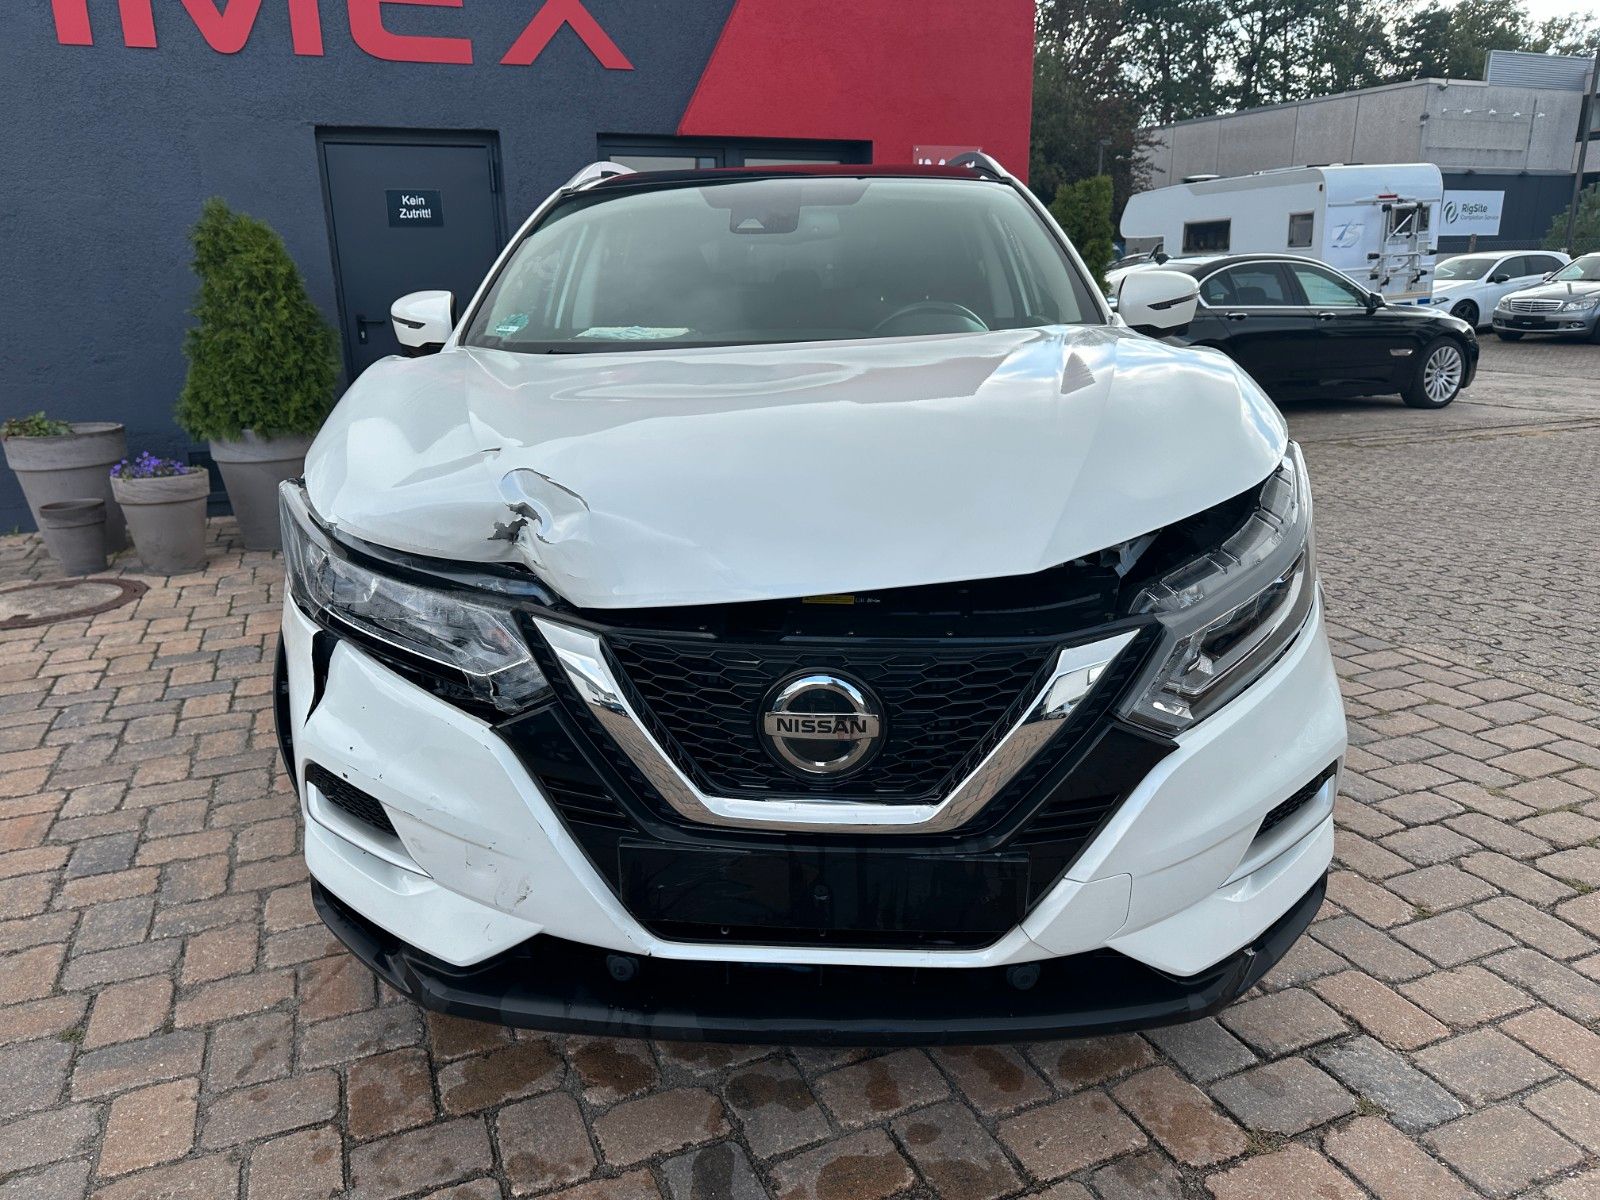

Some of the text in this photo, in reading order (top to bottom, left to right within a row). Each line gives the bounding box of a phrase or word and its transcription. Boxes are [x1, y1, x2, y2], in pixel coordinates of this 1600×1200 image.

[401, 195, 425, 206] Kein
[399, 208, 432, 219] Zutritt!
[1461, 203, 1488, 214] RigSite
[776, 717, 867, 734] NISSAN
